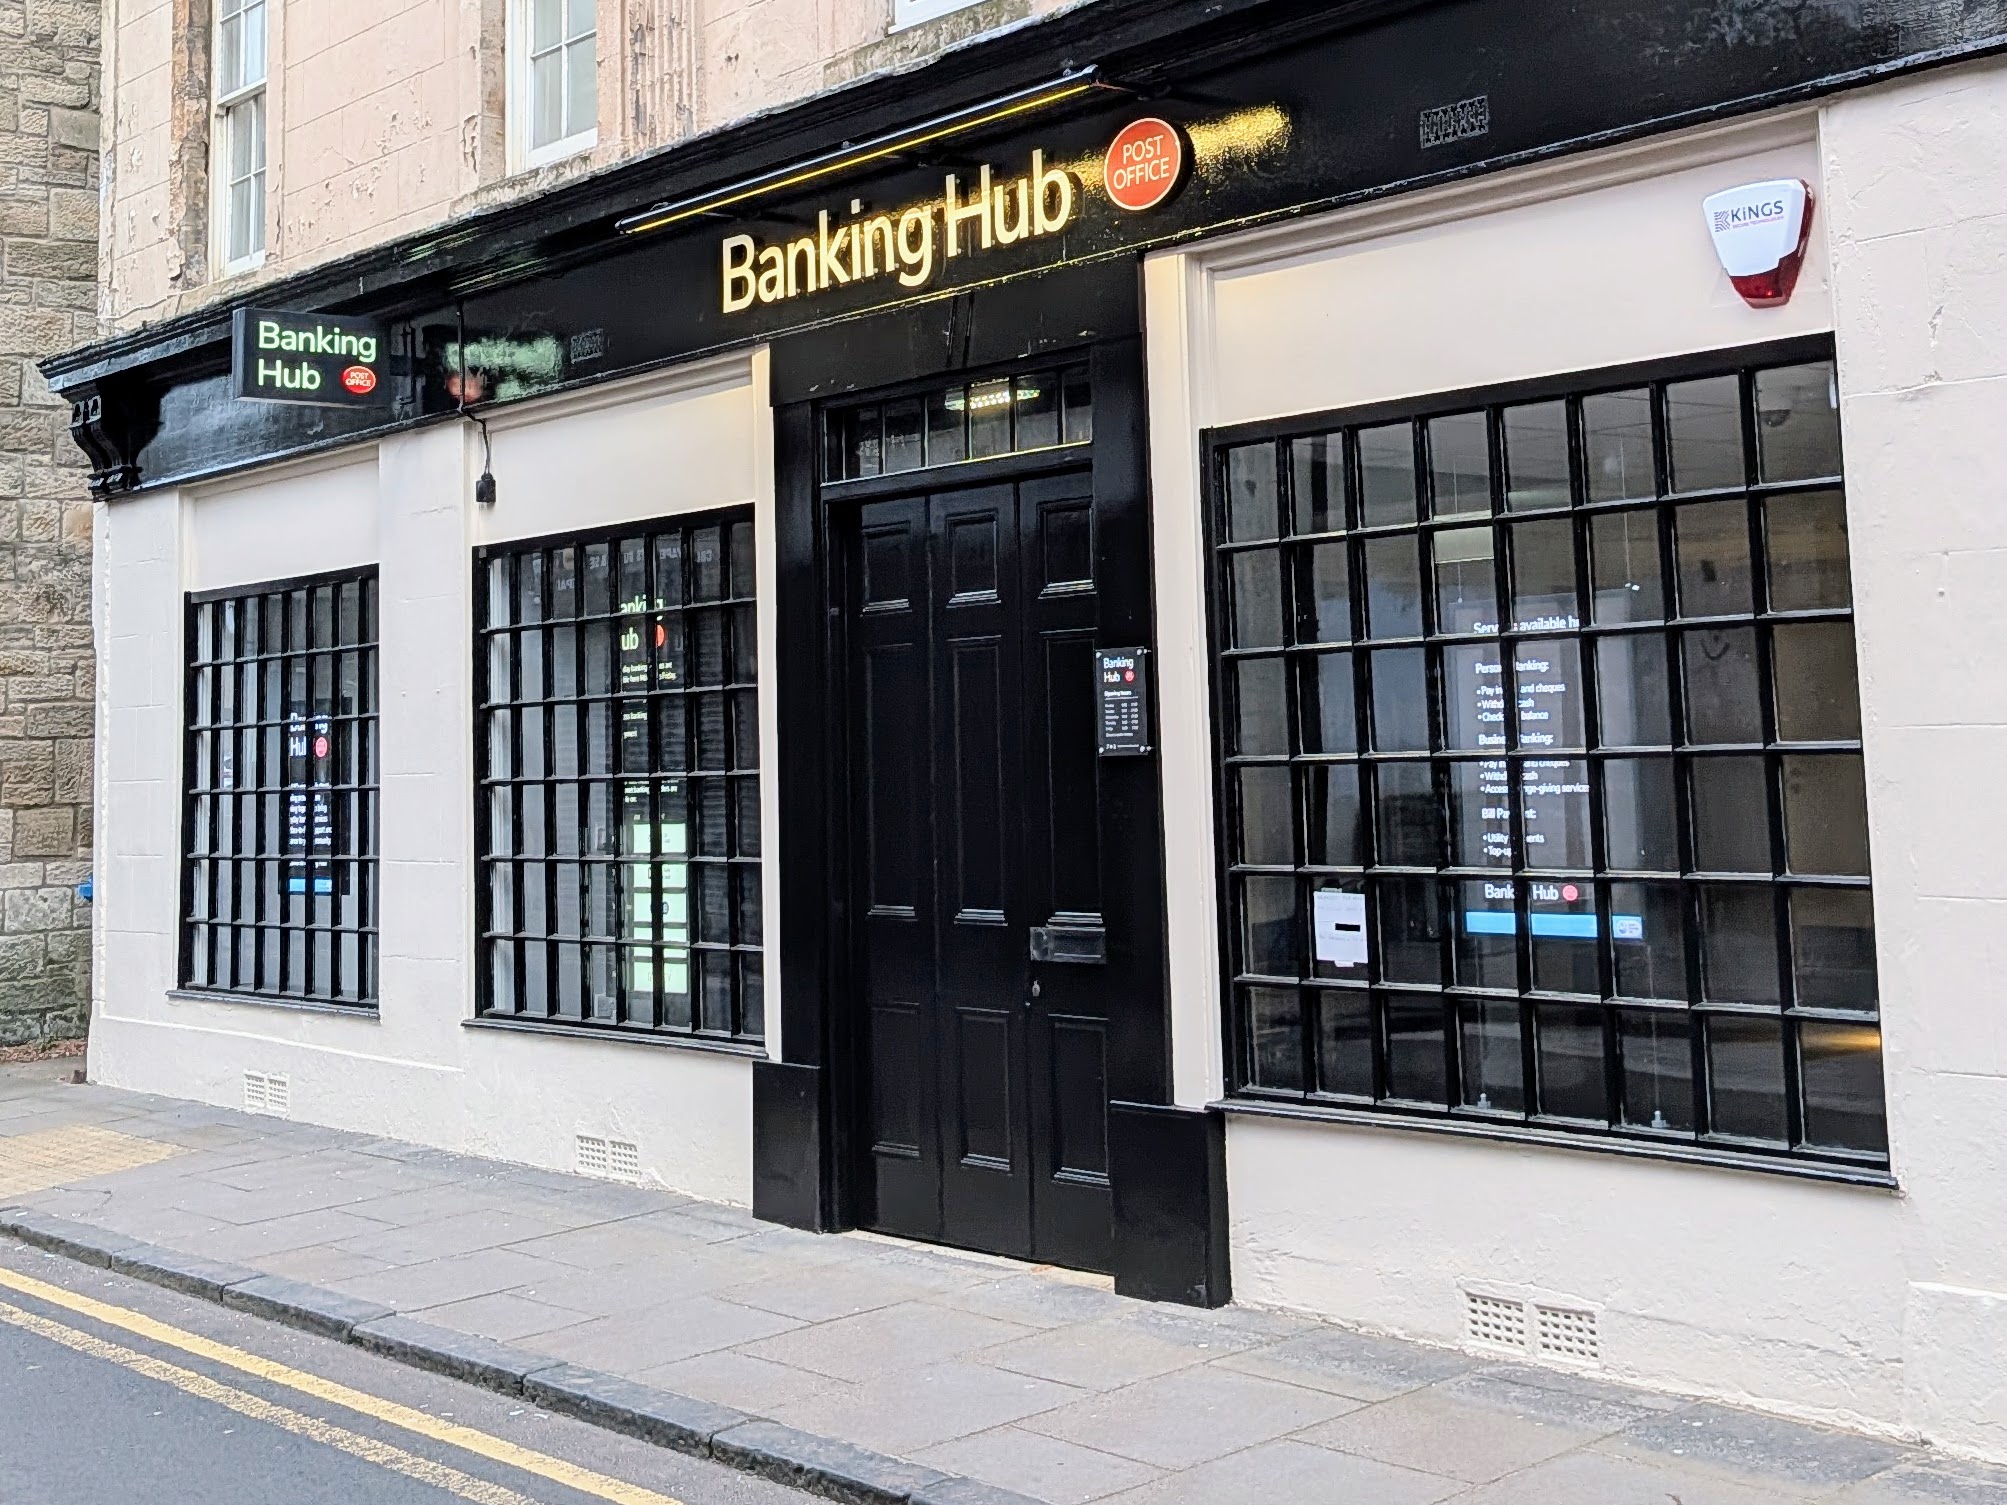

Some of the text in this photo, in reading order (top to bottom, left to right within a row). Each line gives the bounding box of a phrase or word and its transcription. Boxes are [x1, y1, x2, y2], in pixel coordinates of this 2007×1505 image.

[1122, 134, 1164, 165] POST
[1113, 156, 1170, 190] OFFICE
[722, 149, 1072, 314] Banking Hub
[257, 320, 377, 363] Banking
[257, 359, 322, 390] Hub
[345, 378, 372, 387] OFFICE
[350, 371, 369, 380] POST
[1519, 615, 1566, 630] available
[621, 627, 639, 651] ub
[1103, 657, 1134, 669] Banking
[1103, 671, 1121, 683] Hub
[1484, 883, 1515, 898] Bank
[1532, 884, 1559, 899] Hub
